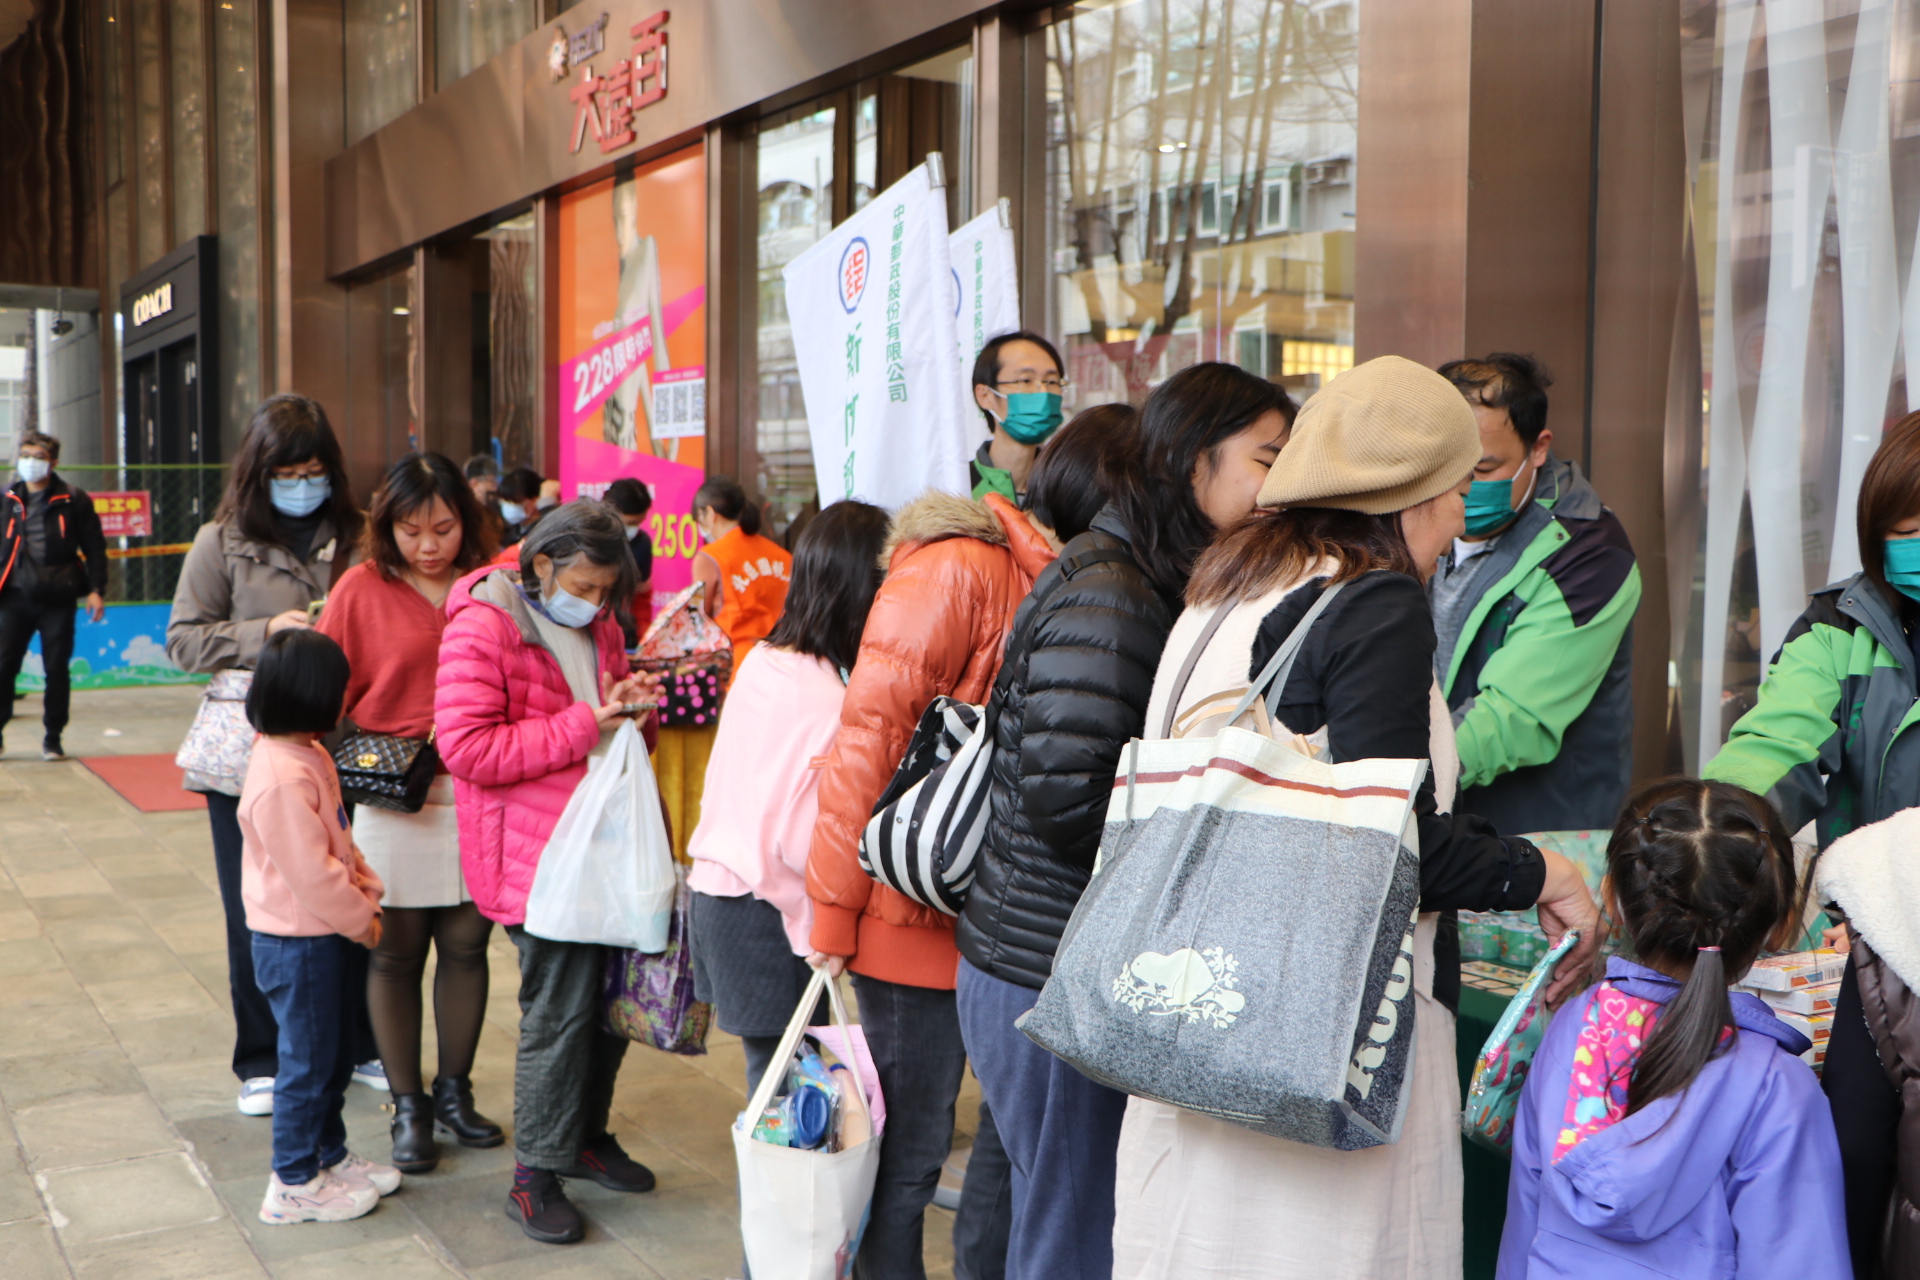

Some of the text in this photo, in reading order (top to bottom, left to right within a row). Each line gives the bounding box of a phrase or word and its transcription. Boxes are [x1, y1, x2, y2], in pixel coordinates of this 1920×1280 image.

[568, 10, 670, 154] 大遠百
[133, 282, 173, 327] COACH
[886, 203, 908, 403] 中華郵政股份有限公司
